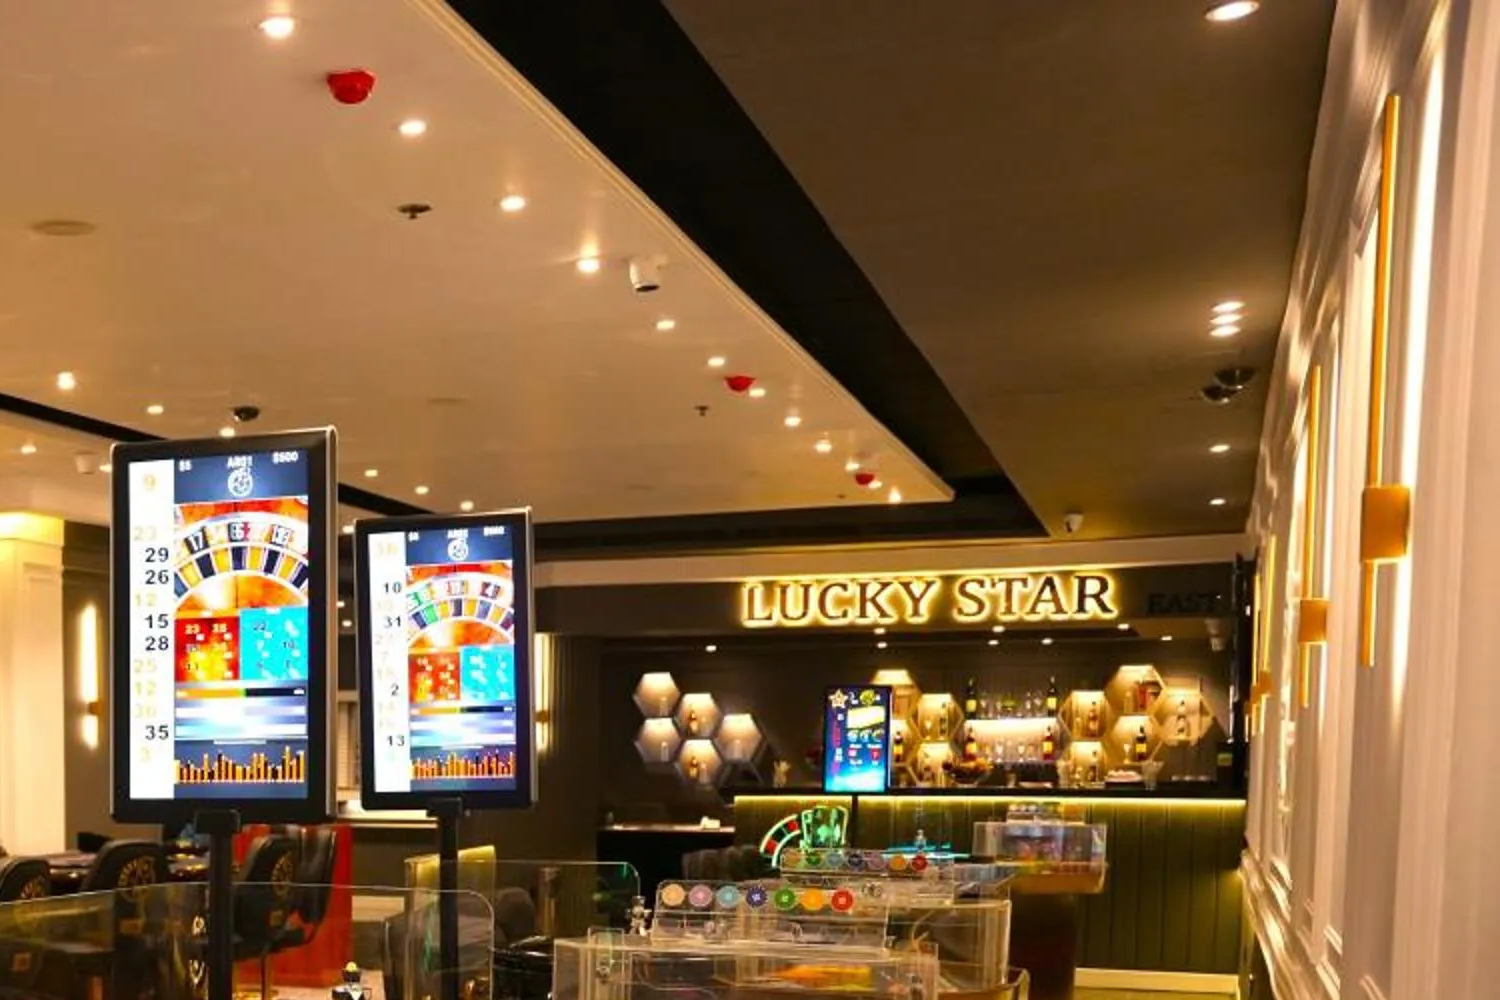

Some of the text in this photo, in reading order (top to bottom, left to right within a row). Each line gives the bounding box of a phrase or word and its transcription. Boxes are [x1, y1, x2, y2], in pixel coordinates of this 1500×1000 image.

[145, 548, 169, 563] 29
[145, 569, 169, 585] 26
[383, 581, 402, 594] 10
[744, 575, 1115, 623] LUCKY STAR
[145, 613, 169, 629] 15
[145, 635, 169, 651] 28
[390, 683, 400, 697] 2
[145, 725, 169, 740] 35
[386, 735, 405, 747] 13
